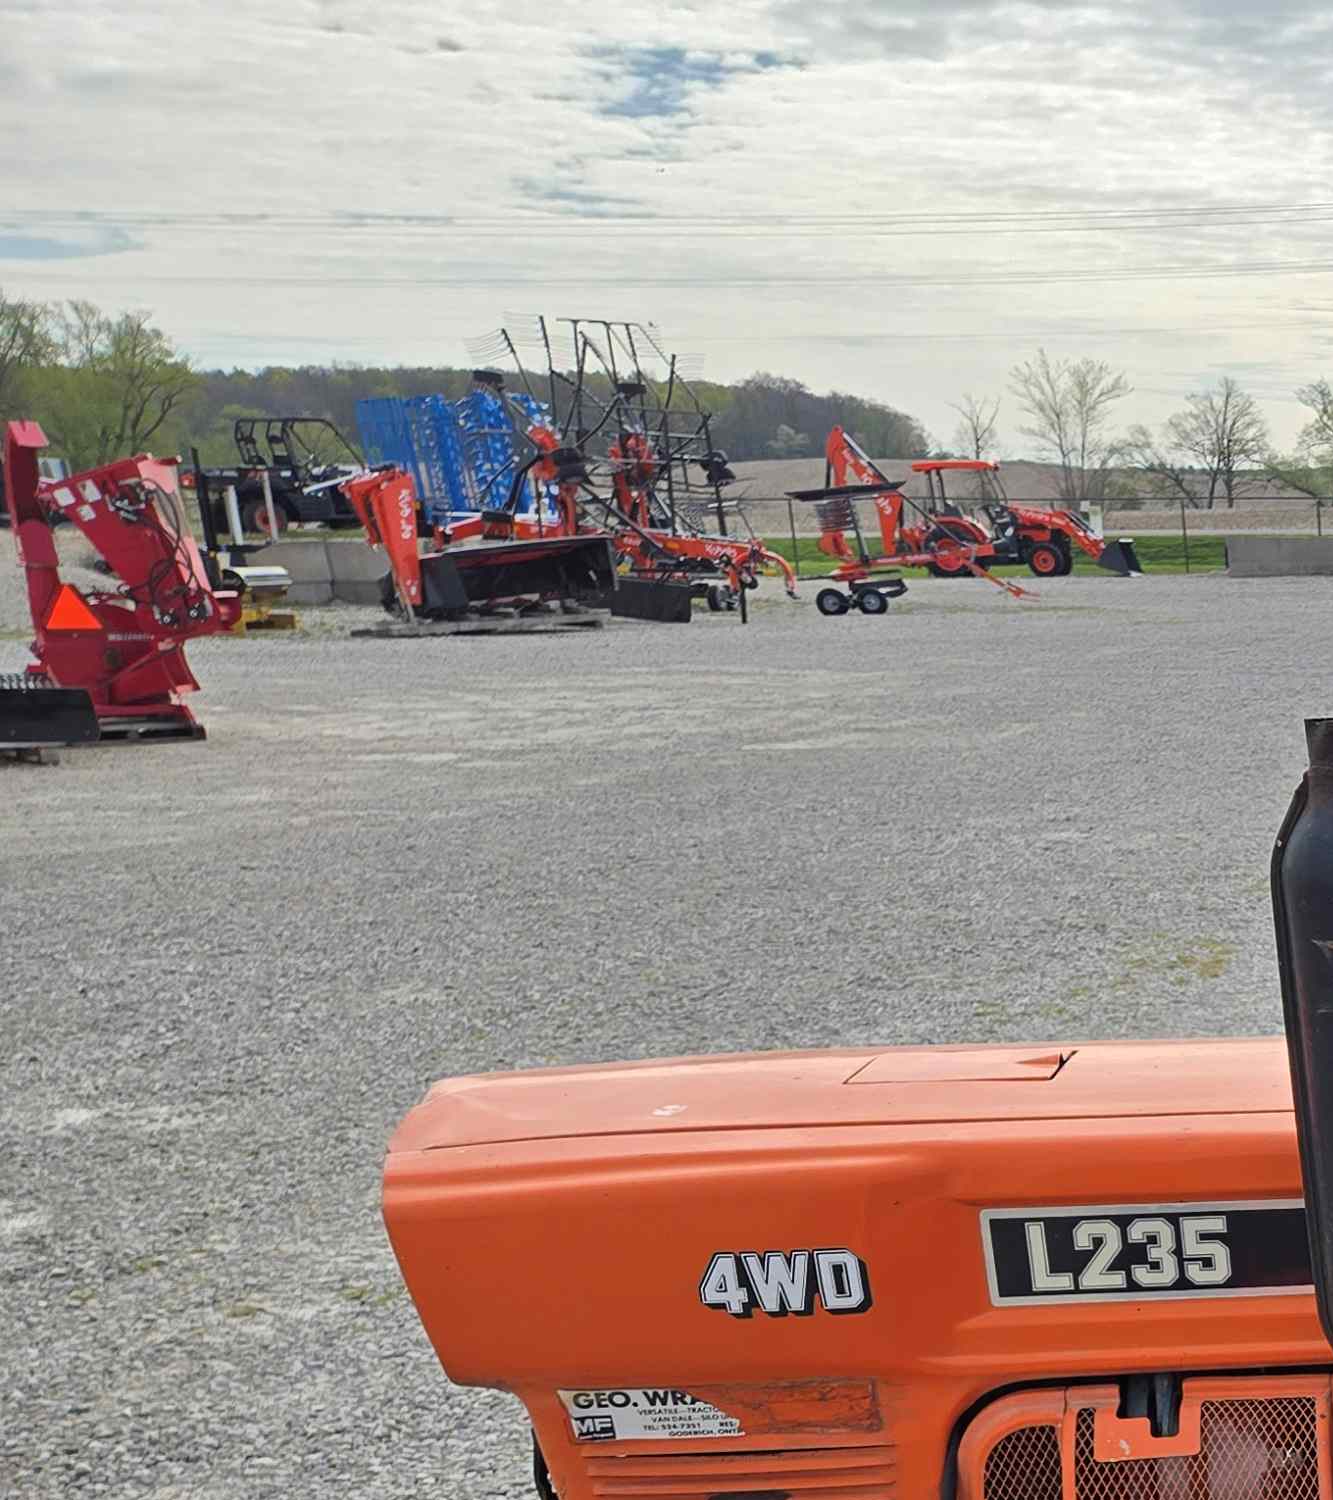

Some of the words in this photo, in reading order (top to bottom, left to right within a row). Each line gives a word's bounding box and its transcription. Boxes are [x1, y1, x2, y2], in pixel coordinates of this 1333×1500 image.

[701, 1248, 871, 1318] 4WD
[1024, 1215, 1232, 1291] L235
[573, 1391, 639, 1409] GEO.
